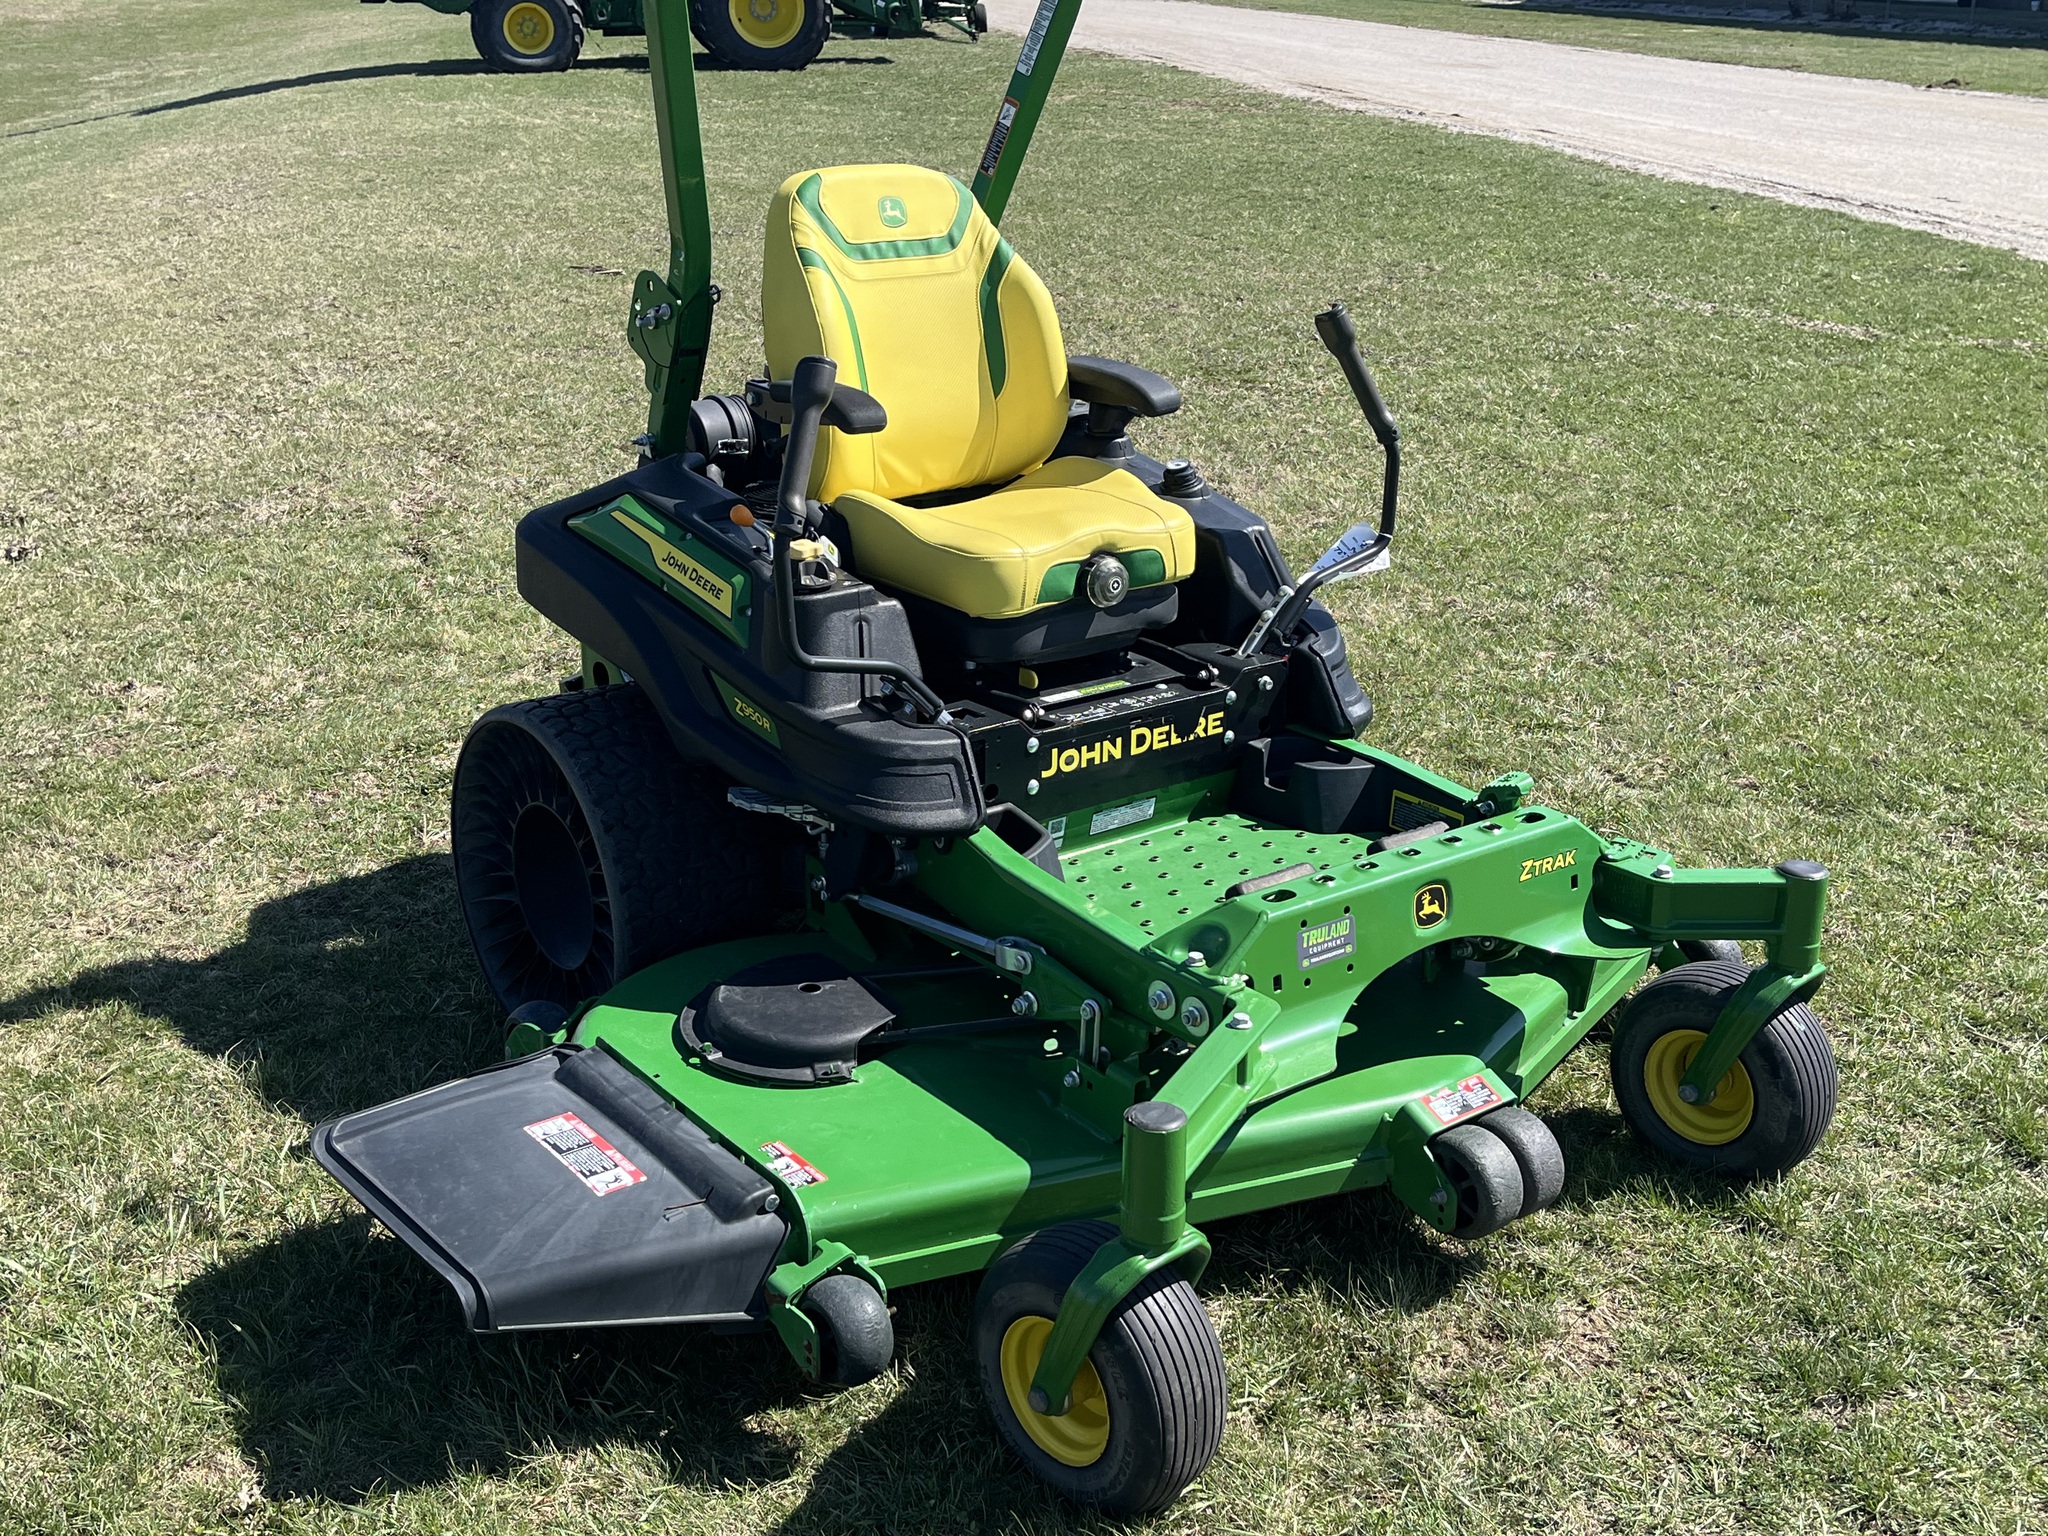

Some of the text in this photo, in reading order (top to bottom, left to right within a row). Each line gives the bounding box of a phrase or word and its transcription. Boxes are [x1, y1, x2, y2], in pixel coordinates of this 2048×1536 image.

[662, 551, 723, 600] JOHN DEERE
[734, 697, 771, 732] Z950R
[1041, 737, 1122, 779] JOHN
[1519, 849, 1577, 882] ZTRAK
[1302, 919, 1350, 948] TRULAND
[1309, 937, 1345, 954] EQUIPMENT
